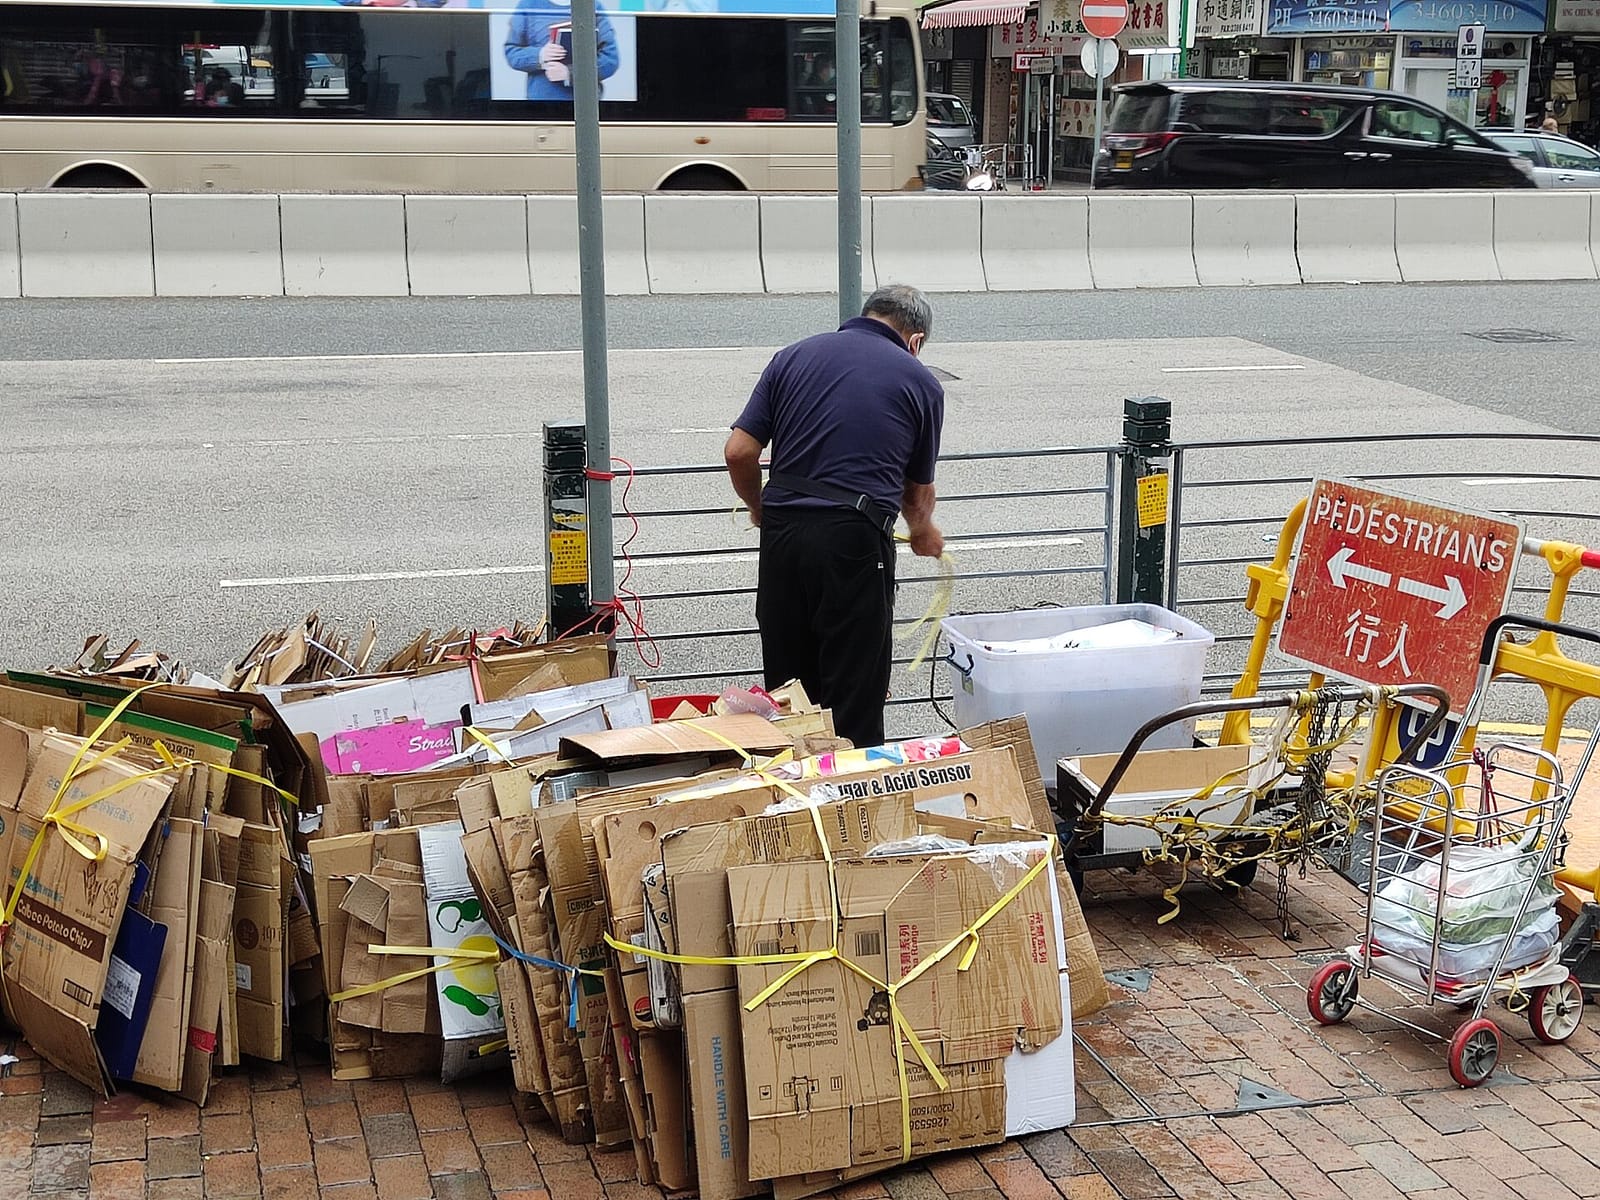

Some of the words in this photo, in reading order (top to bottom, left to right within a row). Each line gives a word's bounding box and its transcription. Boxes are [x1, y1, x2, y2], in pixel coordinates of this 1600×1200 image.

[1308, 9, 1378, 28] 34603410
[1411, 2, 1515, 22] 34603410
[1472, 60, 1477, 70] 7
[1470, 77, 1479, 86] 12
[1313, 496, 1508, 573] PEDESTRIANS
[1343, 609, 1412, 677] 行人
[827, 780, 869, 800] ugar
[871, 780, 883, 795] &
[884, 771, 917, 792] Acid
[919, 764, 971, 786] Sensor
[69, 927, 93, 950] Chips
[712, 1036, 725, 1088] HANDLE
[716, 1089, 727, 1121] WITH
[719, 1124, 731, 1160] CARE
